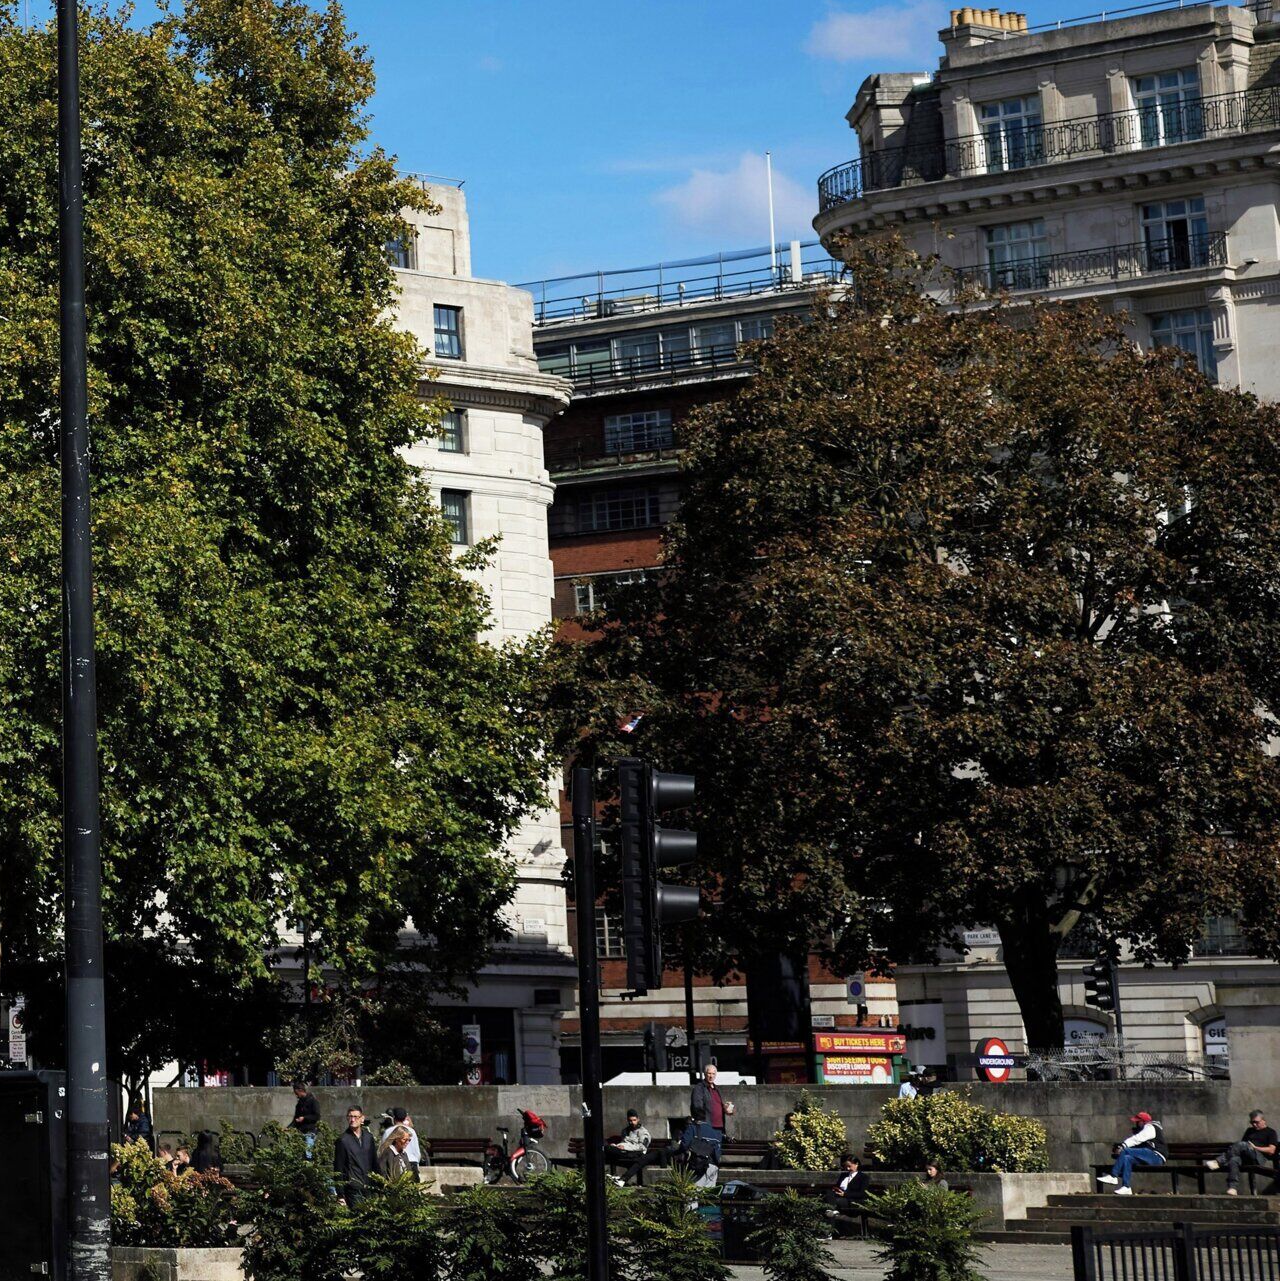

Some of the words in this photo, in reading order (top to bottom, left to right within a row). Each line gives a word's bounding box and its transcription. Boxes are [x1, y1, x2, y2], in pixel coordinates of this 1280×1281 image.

[833, 1037, 844, 1046] BUY
[845, 1038, 869, 1046] TICKETS
[870, 1038, 886, 1047] HERE
[980, 1058, 1014, 1066] UNDERGROUND
[850, 1063, 871, 1071] LONDON
[204, 1074, 227, 1087] SALE
